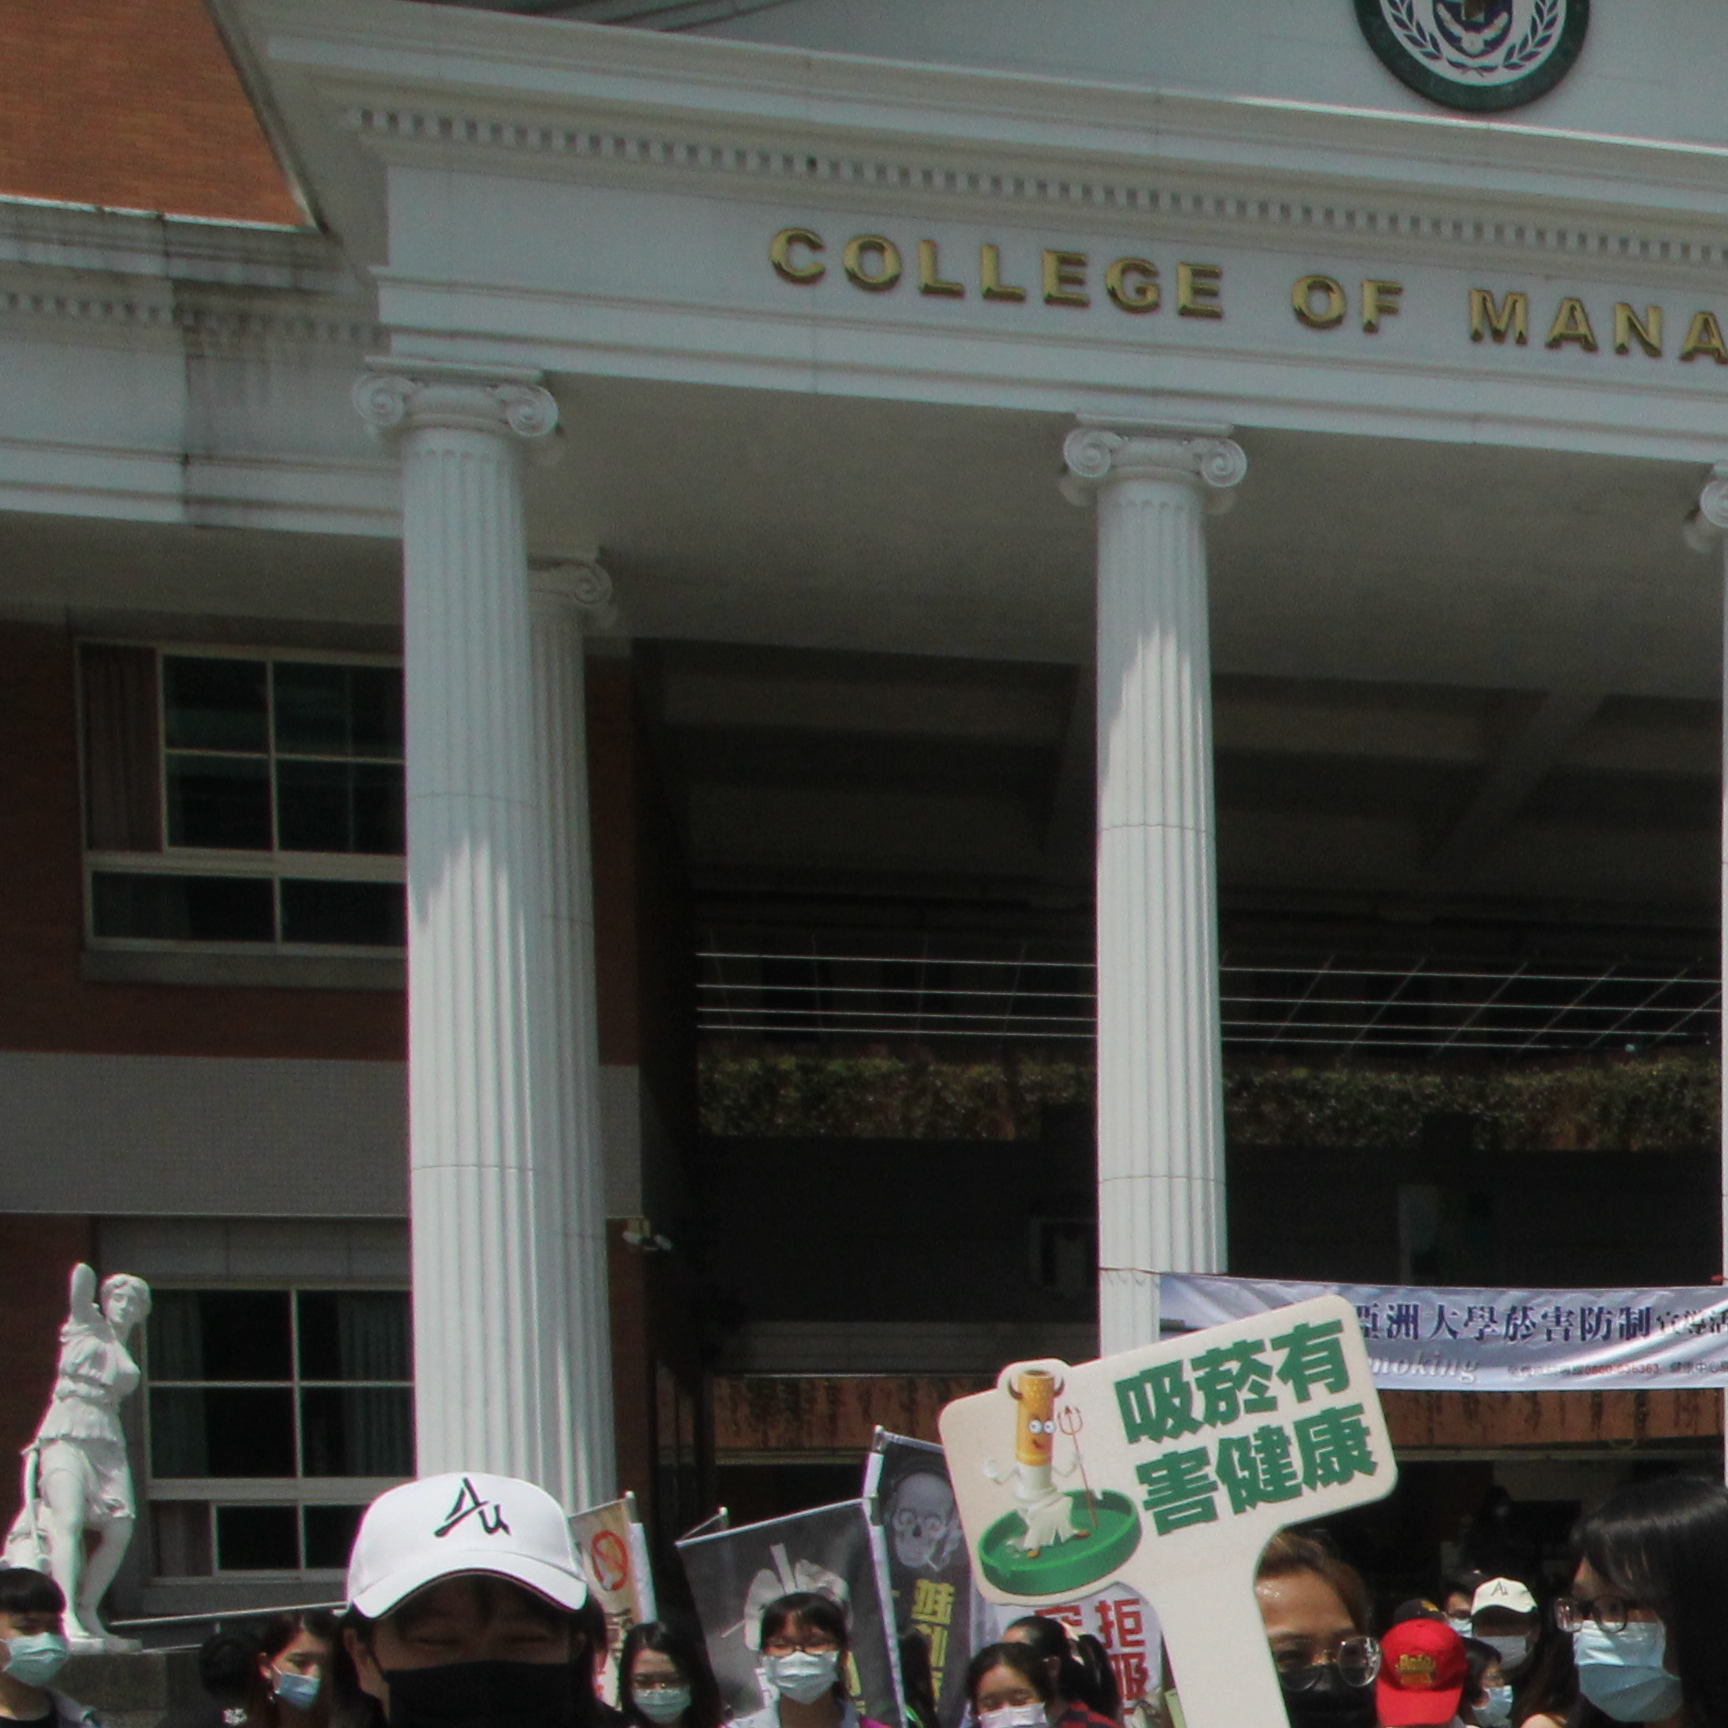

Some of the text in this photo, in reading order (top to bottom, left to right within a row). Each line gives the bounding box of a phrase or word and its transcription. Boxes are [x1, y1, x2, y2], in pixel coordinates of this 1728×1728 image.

[768, 226, 1224, 320] COLLEGE
[1288, 272, 1406, 333] OF
[1113, 1315, 1354, 1446] 吸菸有
[1367, 1351, 1479, 1383] moking
[1134, 1401, 1379, 1536] 害健康
